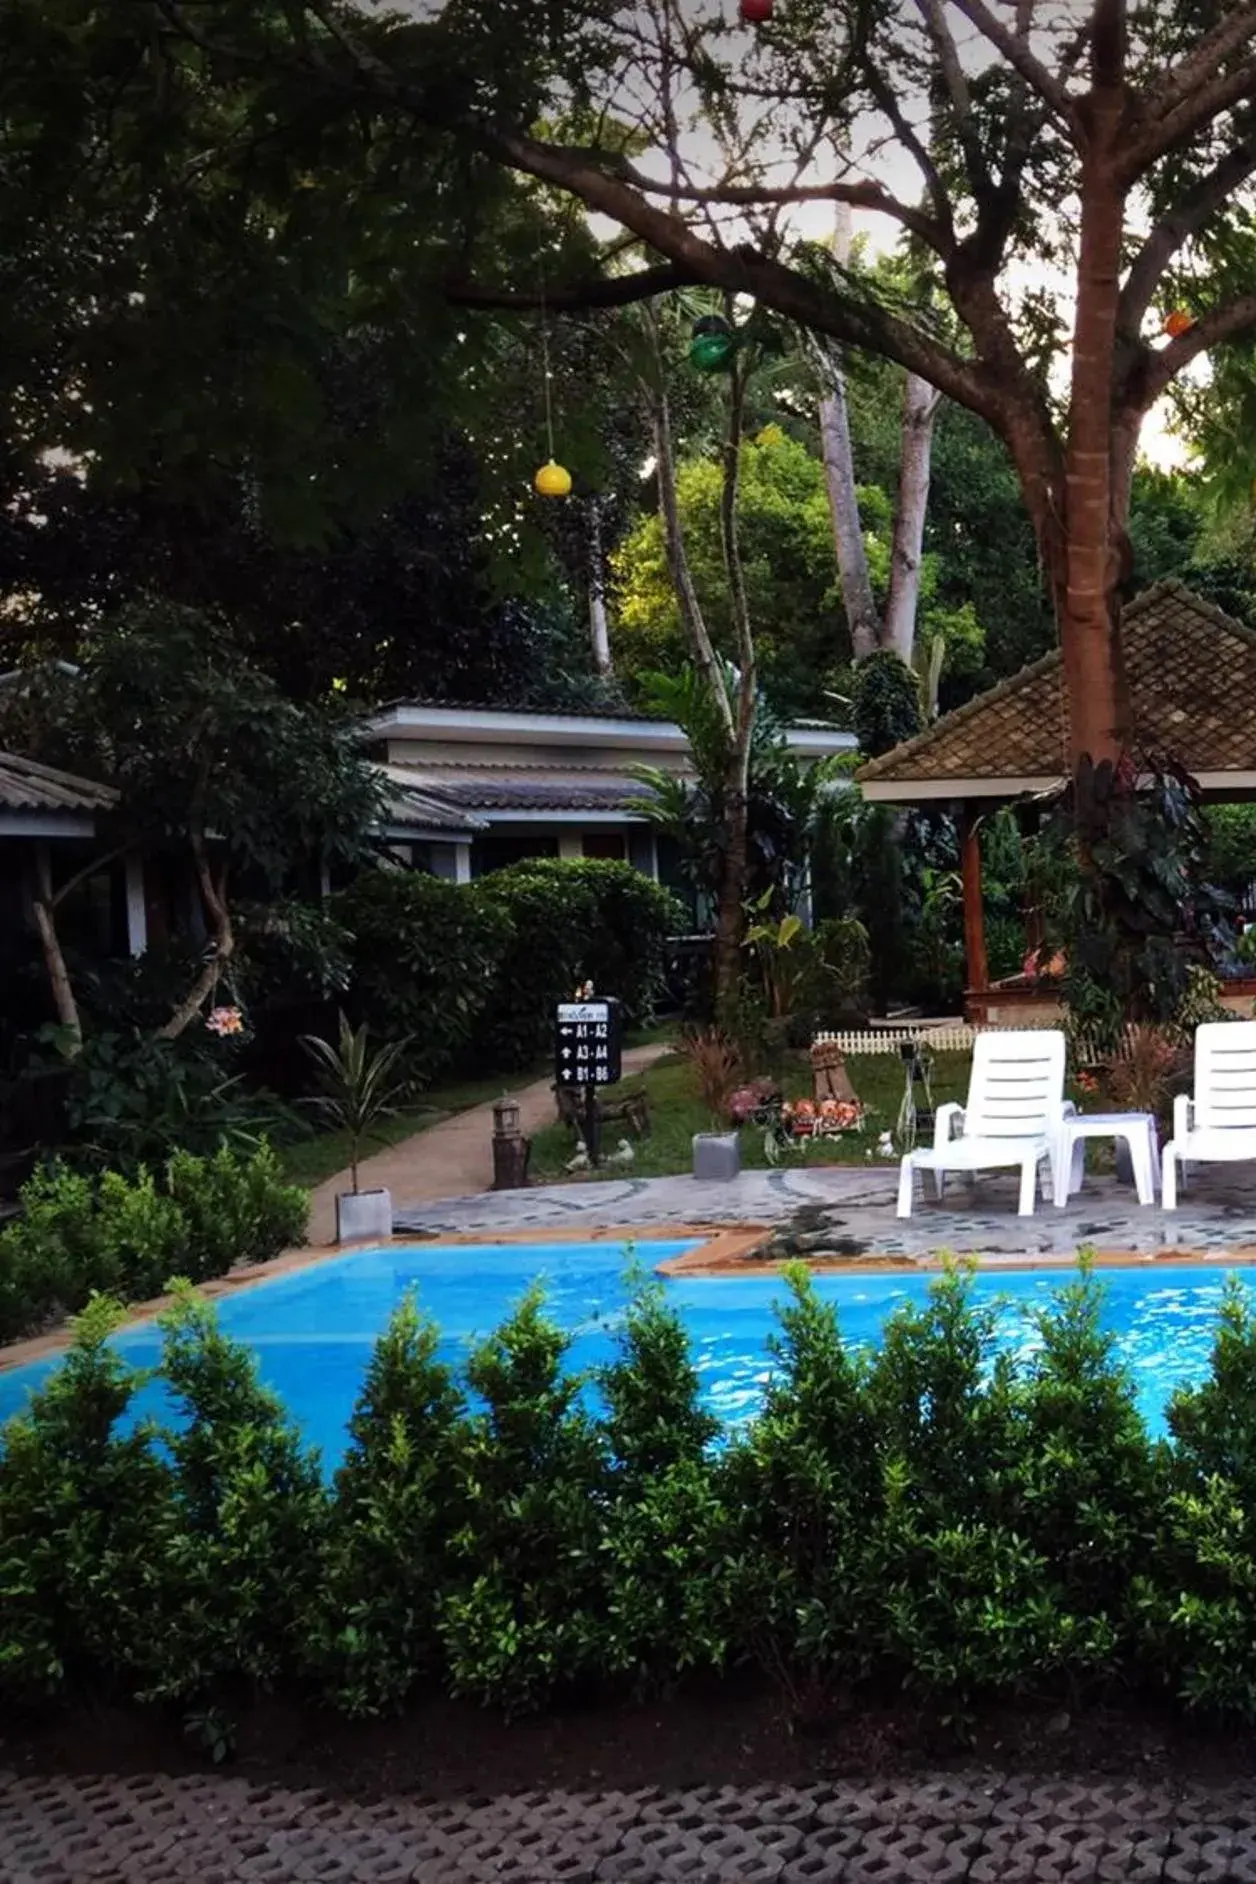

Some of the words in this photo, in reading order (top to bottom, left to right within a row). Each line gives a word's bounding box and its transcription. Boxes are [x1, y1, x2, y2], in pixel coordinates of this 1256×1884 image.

[576, 1023, 587, 1038] A1
[595, 1023, 607, 1038] A2
[576, 1044, 588, 1059] A3
[595, 1044, 607, 1059] A4
[577, 1066, 588, 1081] B1
